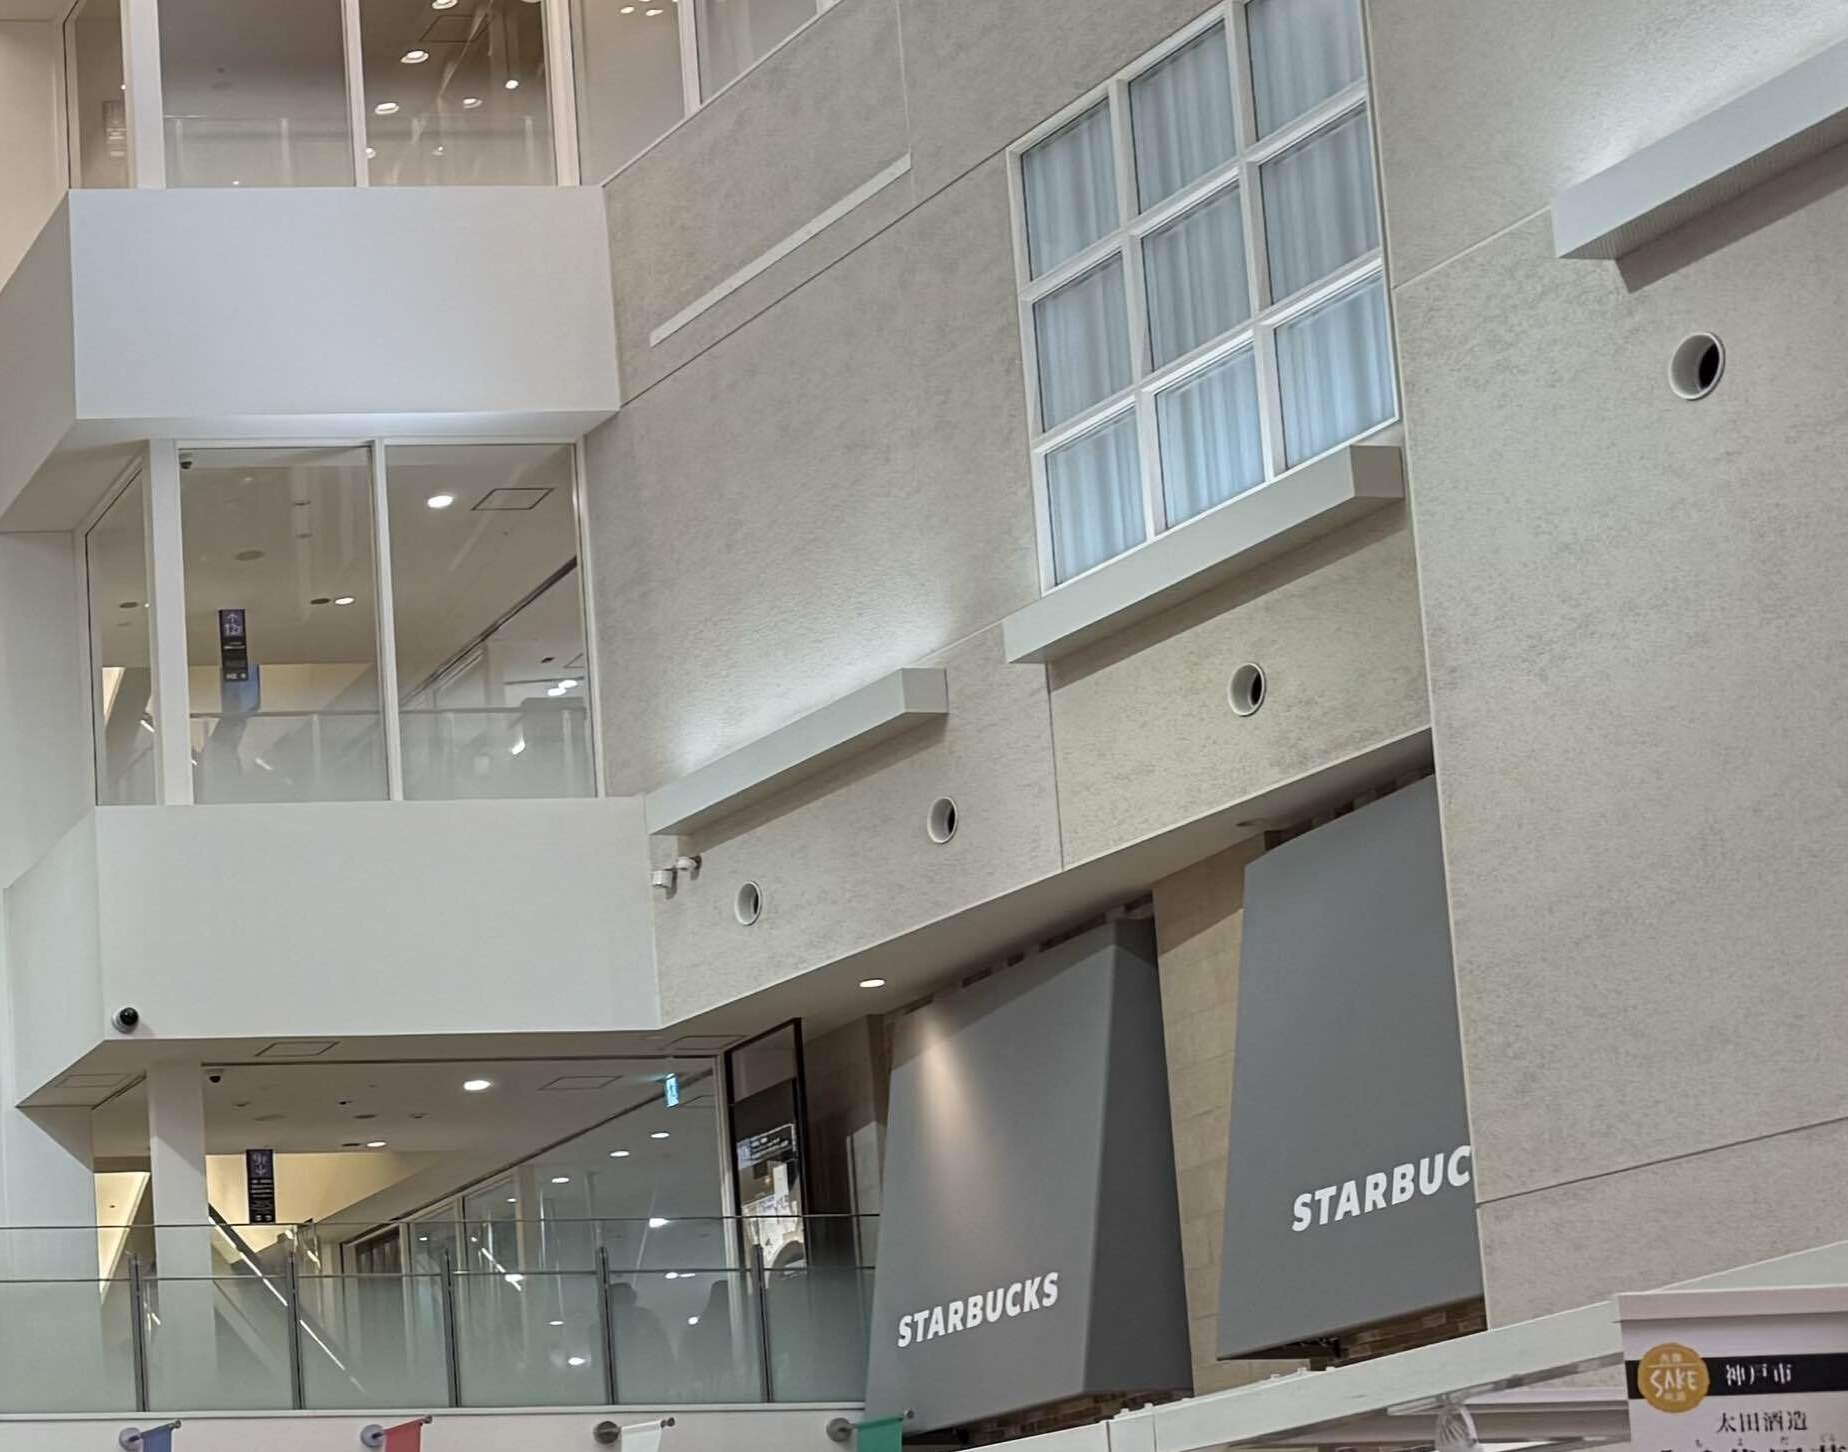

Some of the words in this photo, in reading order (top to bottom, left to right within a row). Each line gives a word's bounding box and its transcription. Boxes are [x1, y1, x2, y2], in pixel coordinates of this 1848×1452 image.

[1291, 1145, 1471, 1232] STARBUC
[898, 1272, 1060, 1348] STARBUCKS
[1725, 1363, 1792, 1386] 神戸市
[1716, 1410, 1808, 1434] 太田酒造
